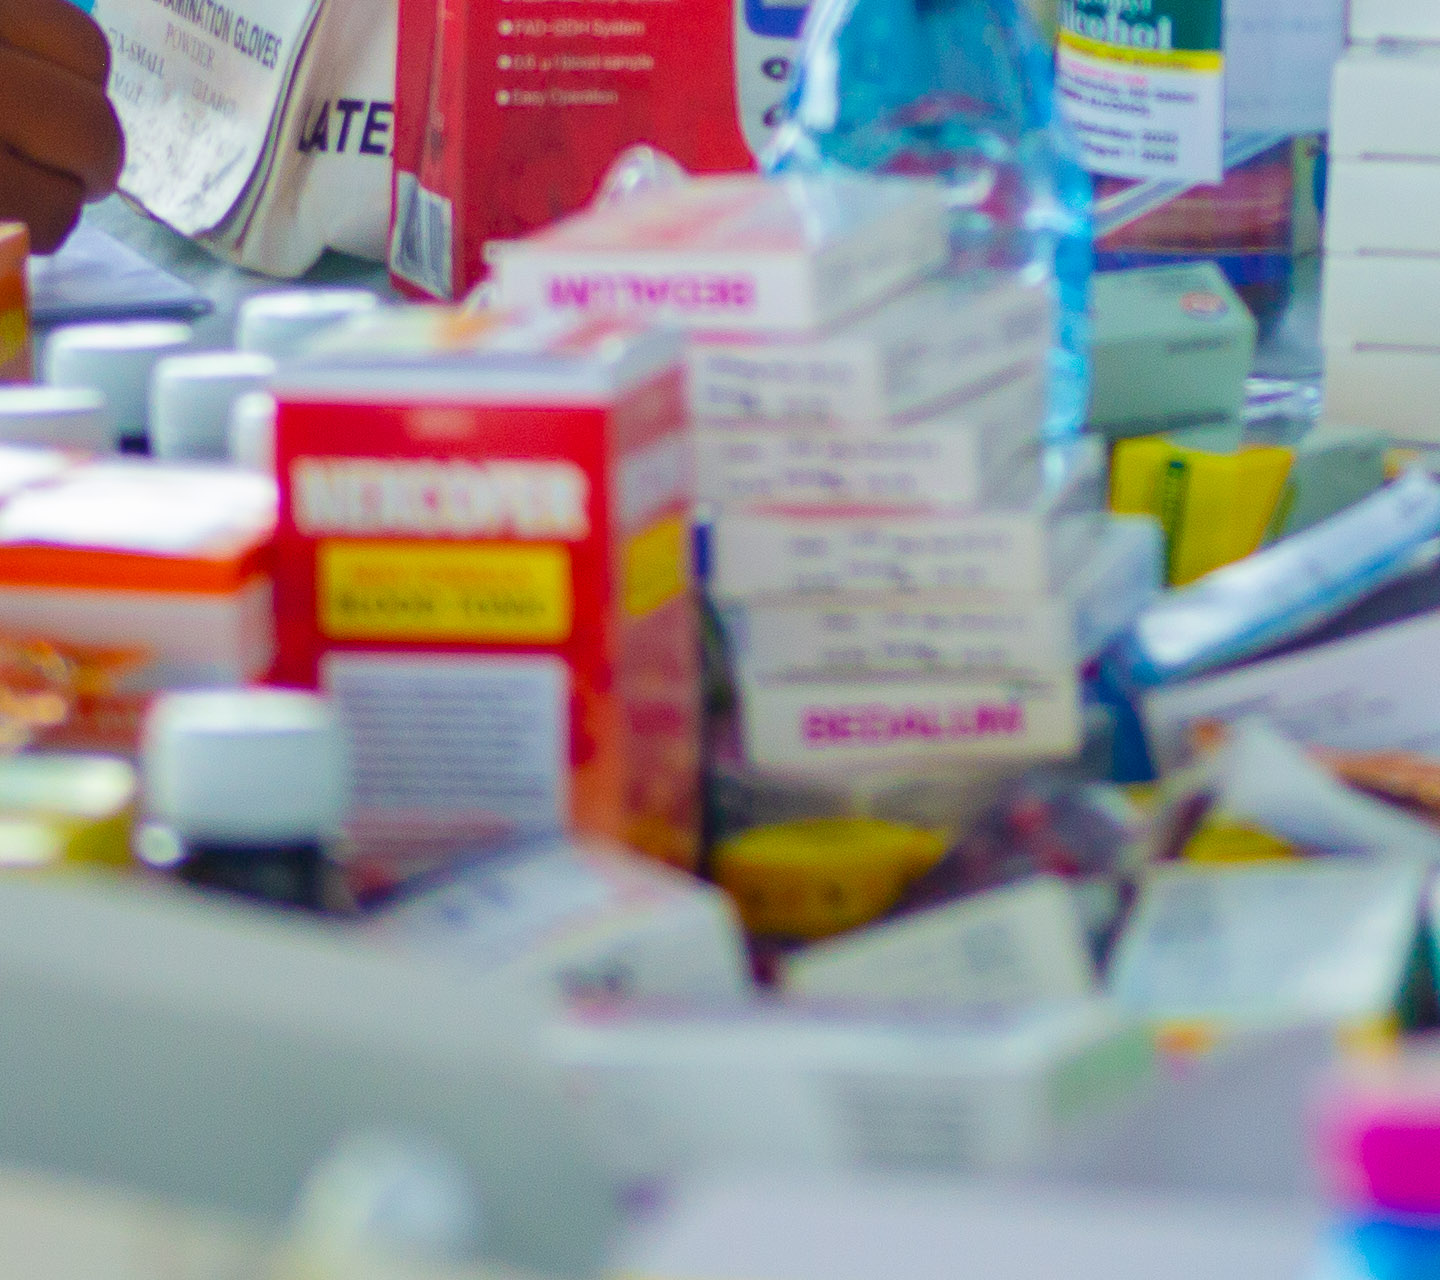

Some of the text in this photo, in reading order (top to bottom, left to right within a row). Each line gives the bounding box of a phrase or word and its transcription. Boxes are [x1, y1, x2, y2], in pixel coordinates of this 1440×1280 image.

[166, 22, 216, 71] POWDER
[234, 16, 283, 70] GLOVES
[298, 98, 396, 159] LATE
